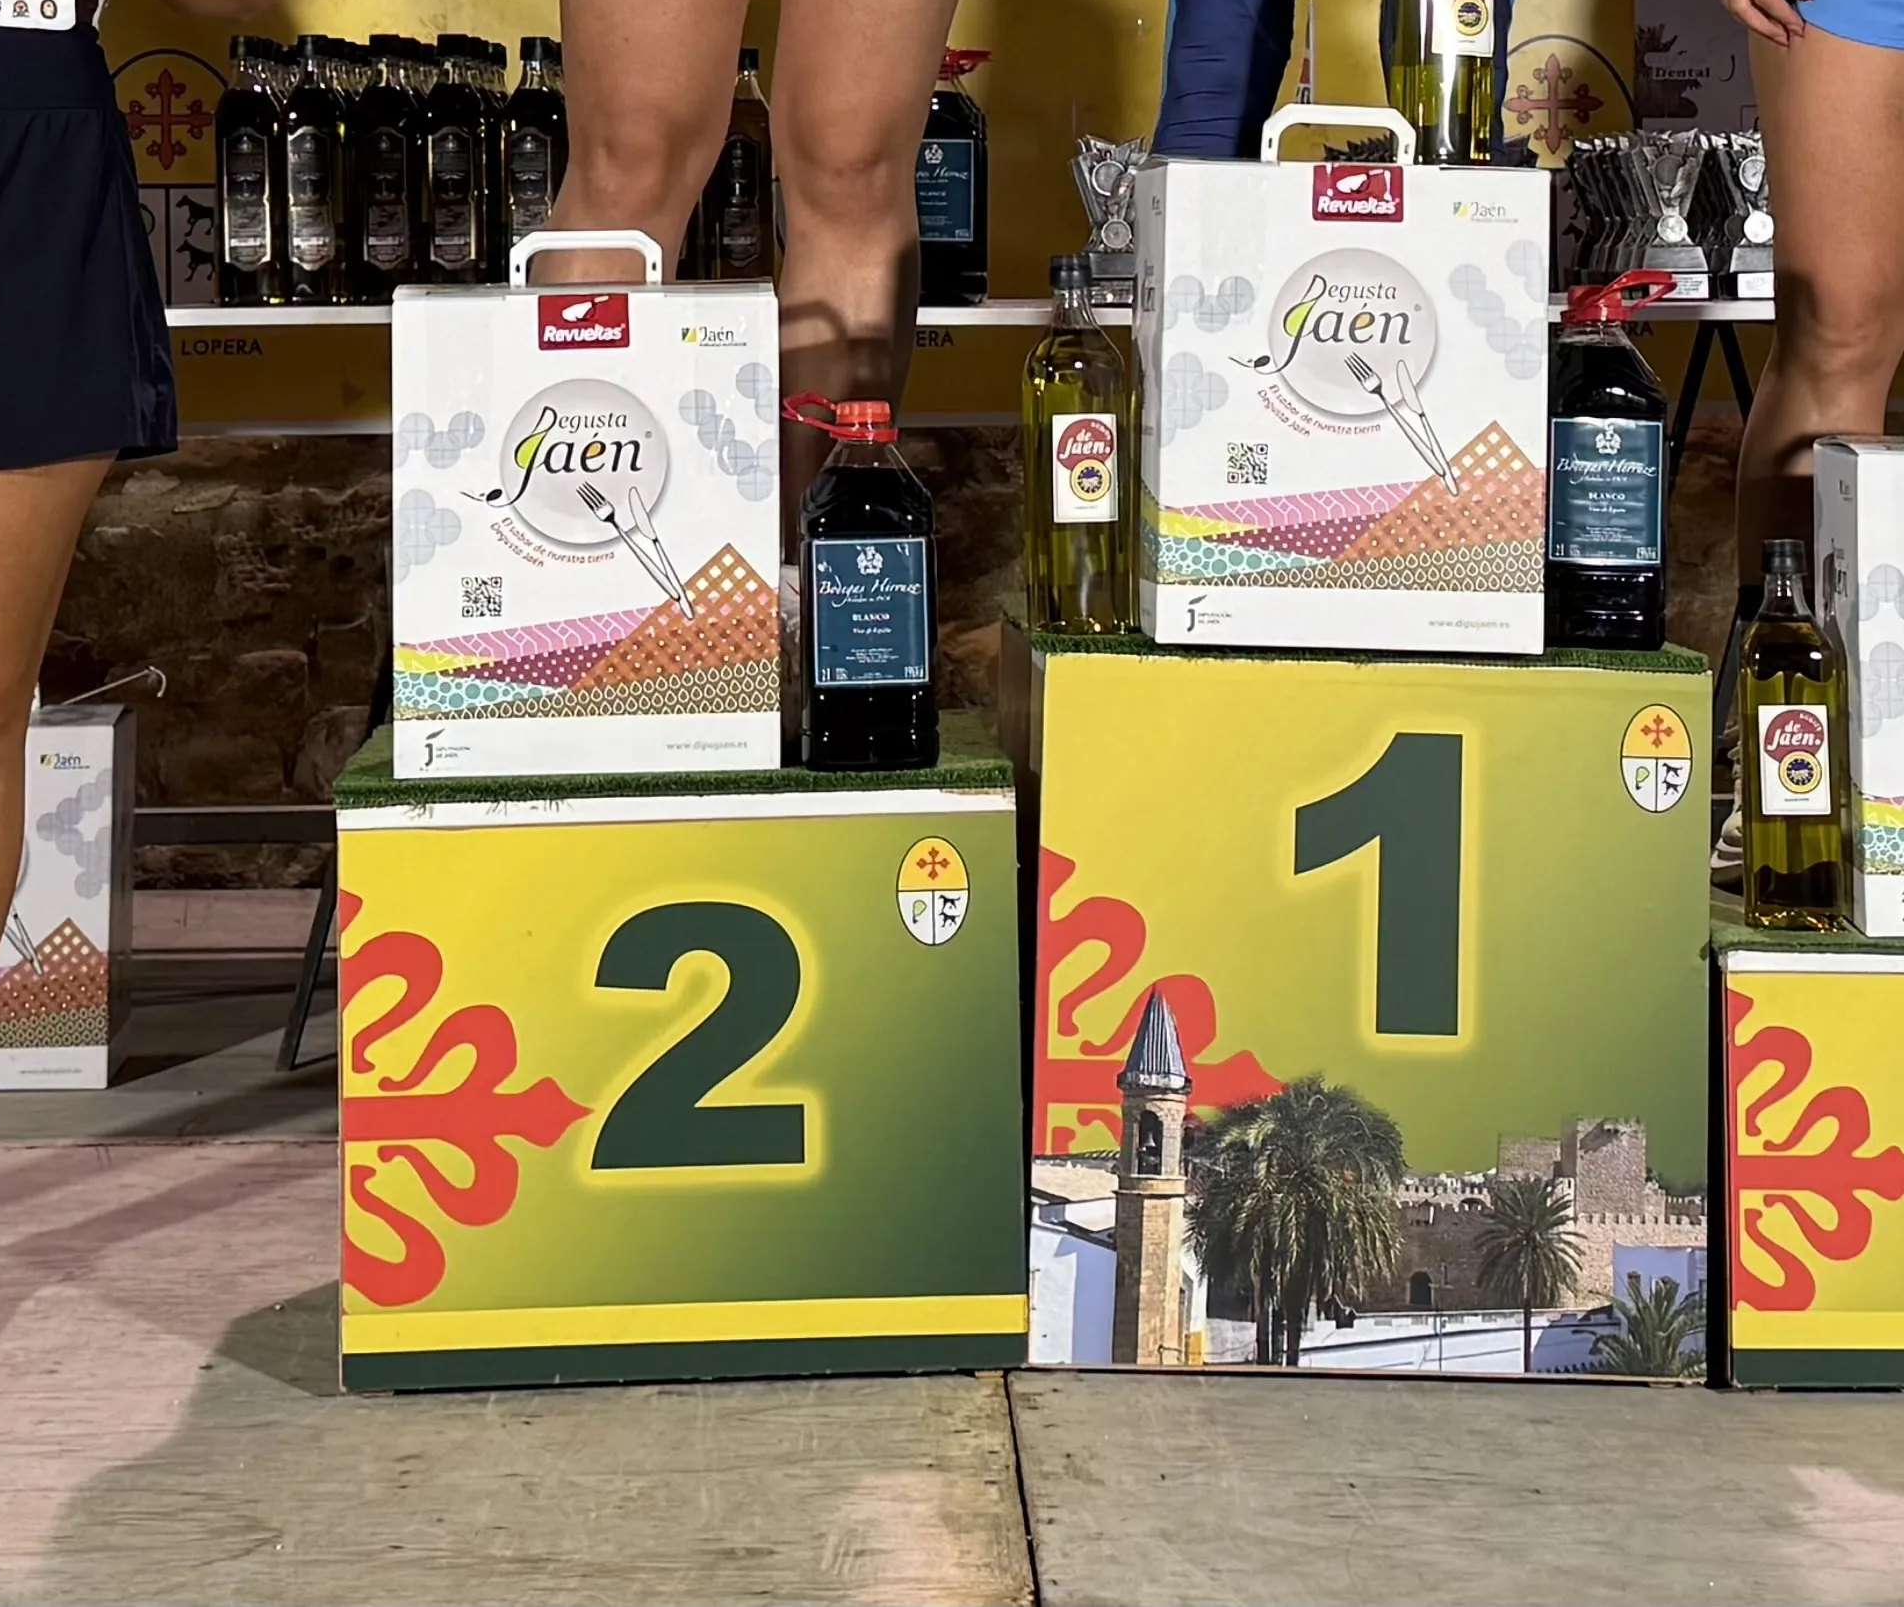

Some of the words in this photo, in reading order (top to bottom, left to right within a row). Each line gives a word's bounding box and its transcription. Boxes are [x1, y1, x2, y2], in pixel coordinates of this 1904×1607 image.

[1317, 196, 1397, 215] Revueltas
[1300, 274, 1397, 304] Degusta
[543, 325, 623, 342] Revueltas
[699, 326, 735, 342] Jaén
[916, 330, 955, 347] ERA
[1278, 300, 1412, 374] Jaén
[181, 339, 264, 356] LOPERA
[532, 406, 628, 434] Degusta
[508, 432, 643, 507] Jaén
[1784, 720, 1801, 732] de
[1294, 732, 1463, 1036] 1
[590, 901, 806, 1171] 2
